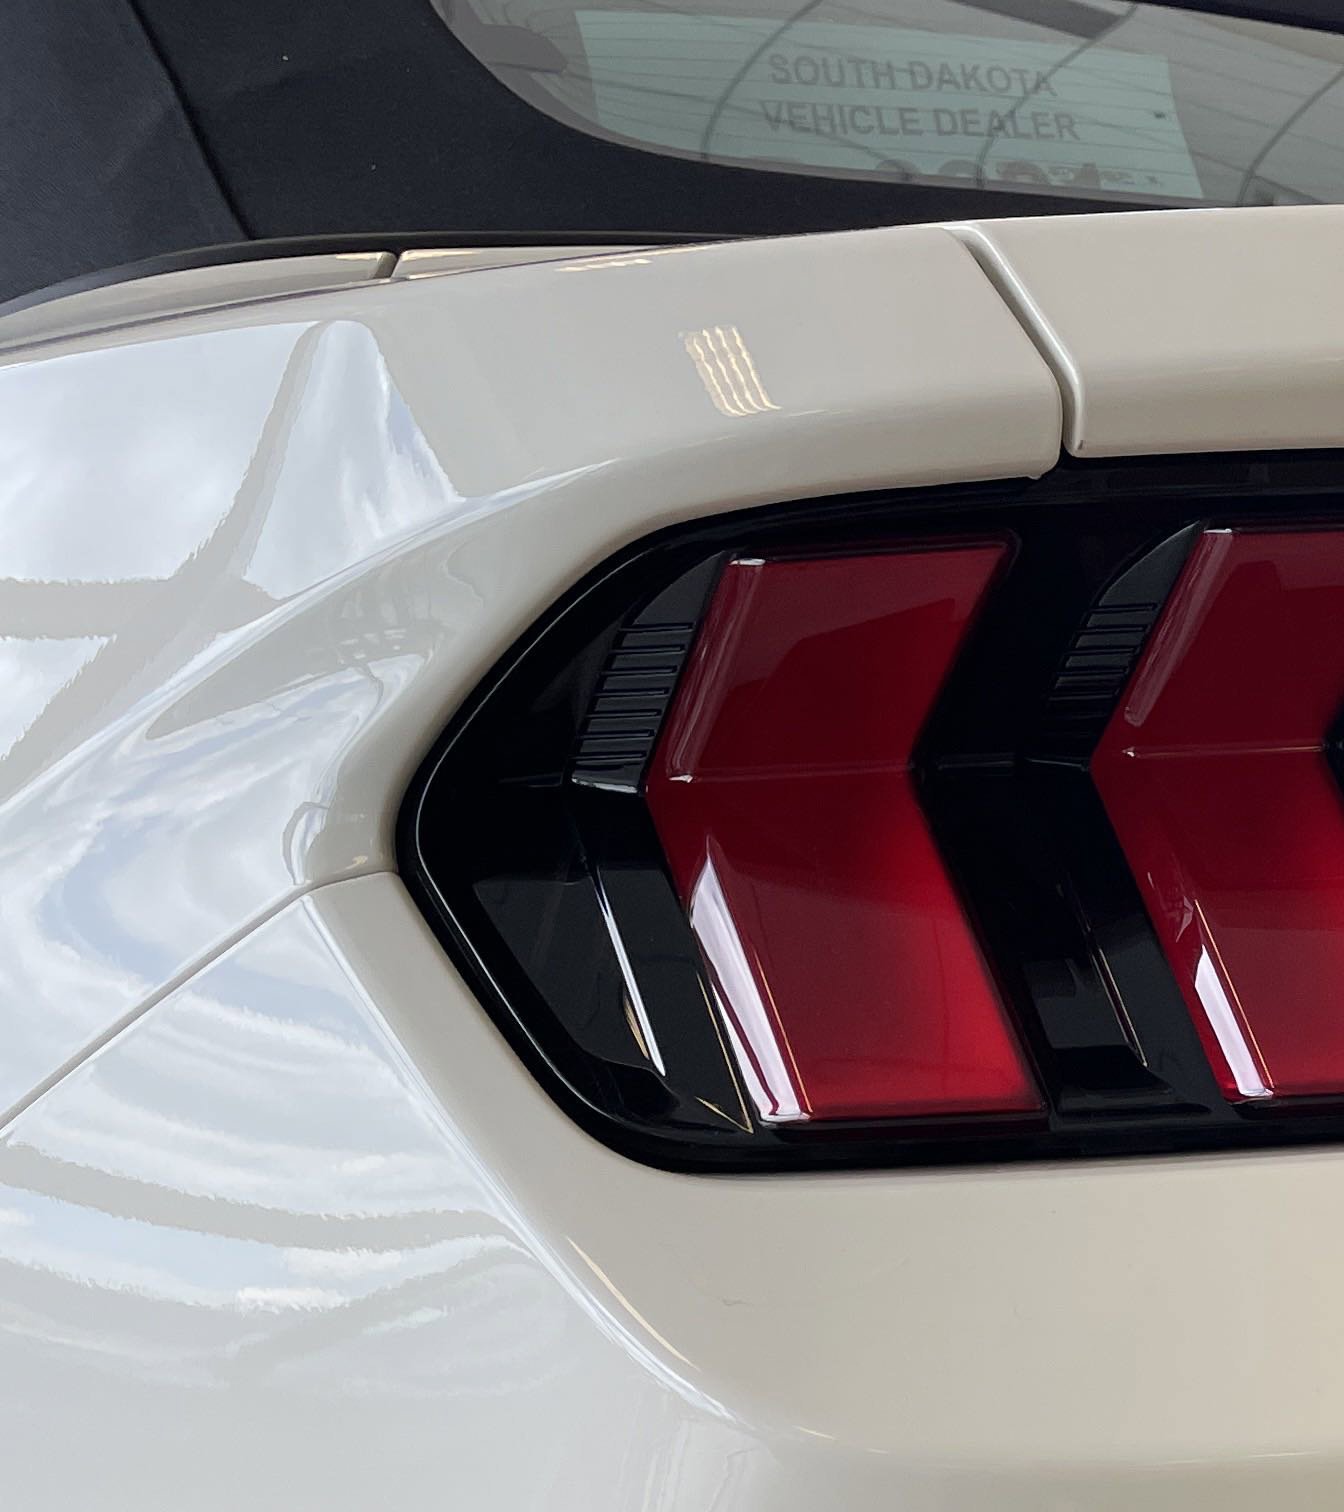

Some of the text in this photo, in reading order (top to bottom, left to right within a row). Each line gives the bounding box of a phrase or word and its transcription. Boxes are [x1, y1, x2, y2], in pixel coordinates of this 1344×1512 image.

[768, 53, 1058, 96] SOUTH DAKOTA
[761, 101, 1081, 141] VEHICLE DEALER
